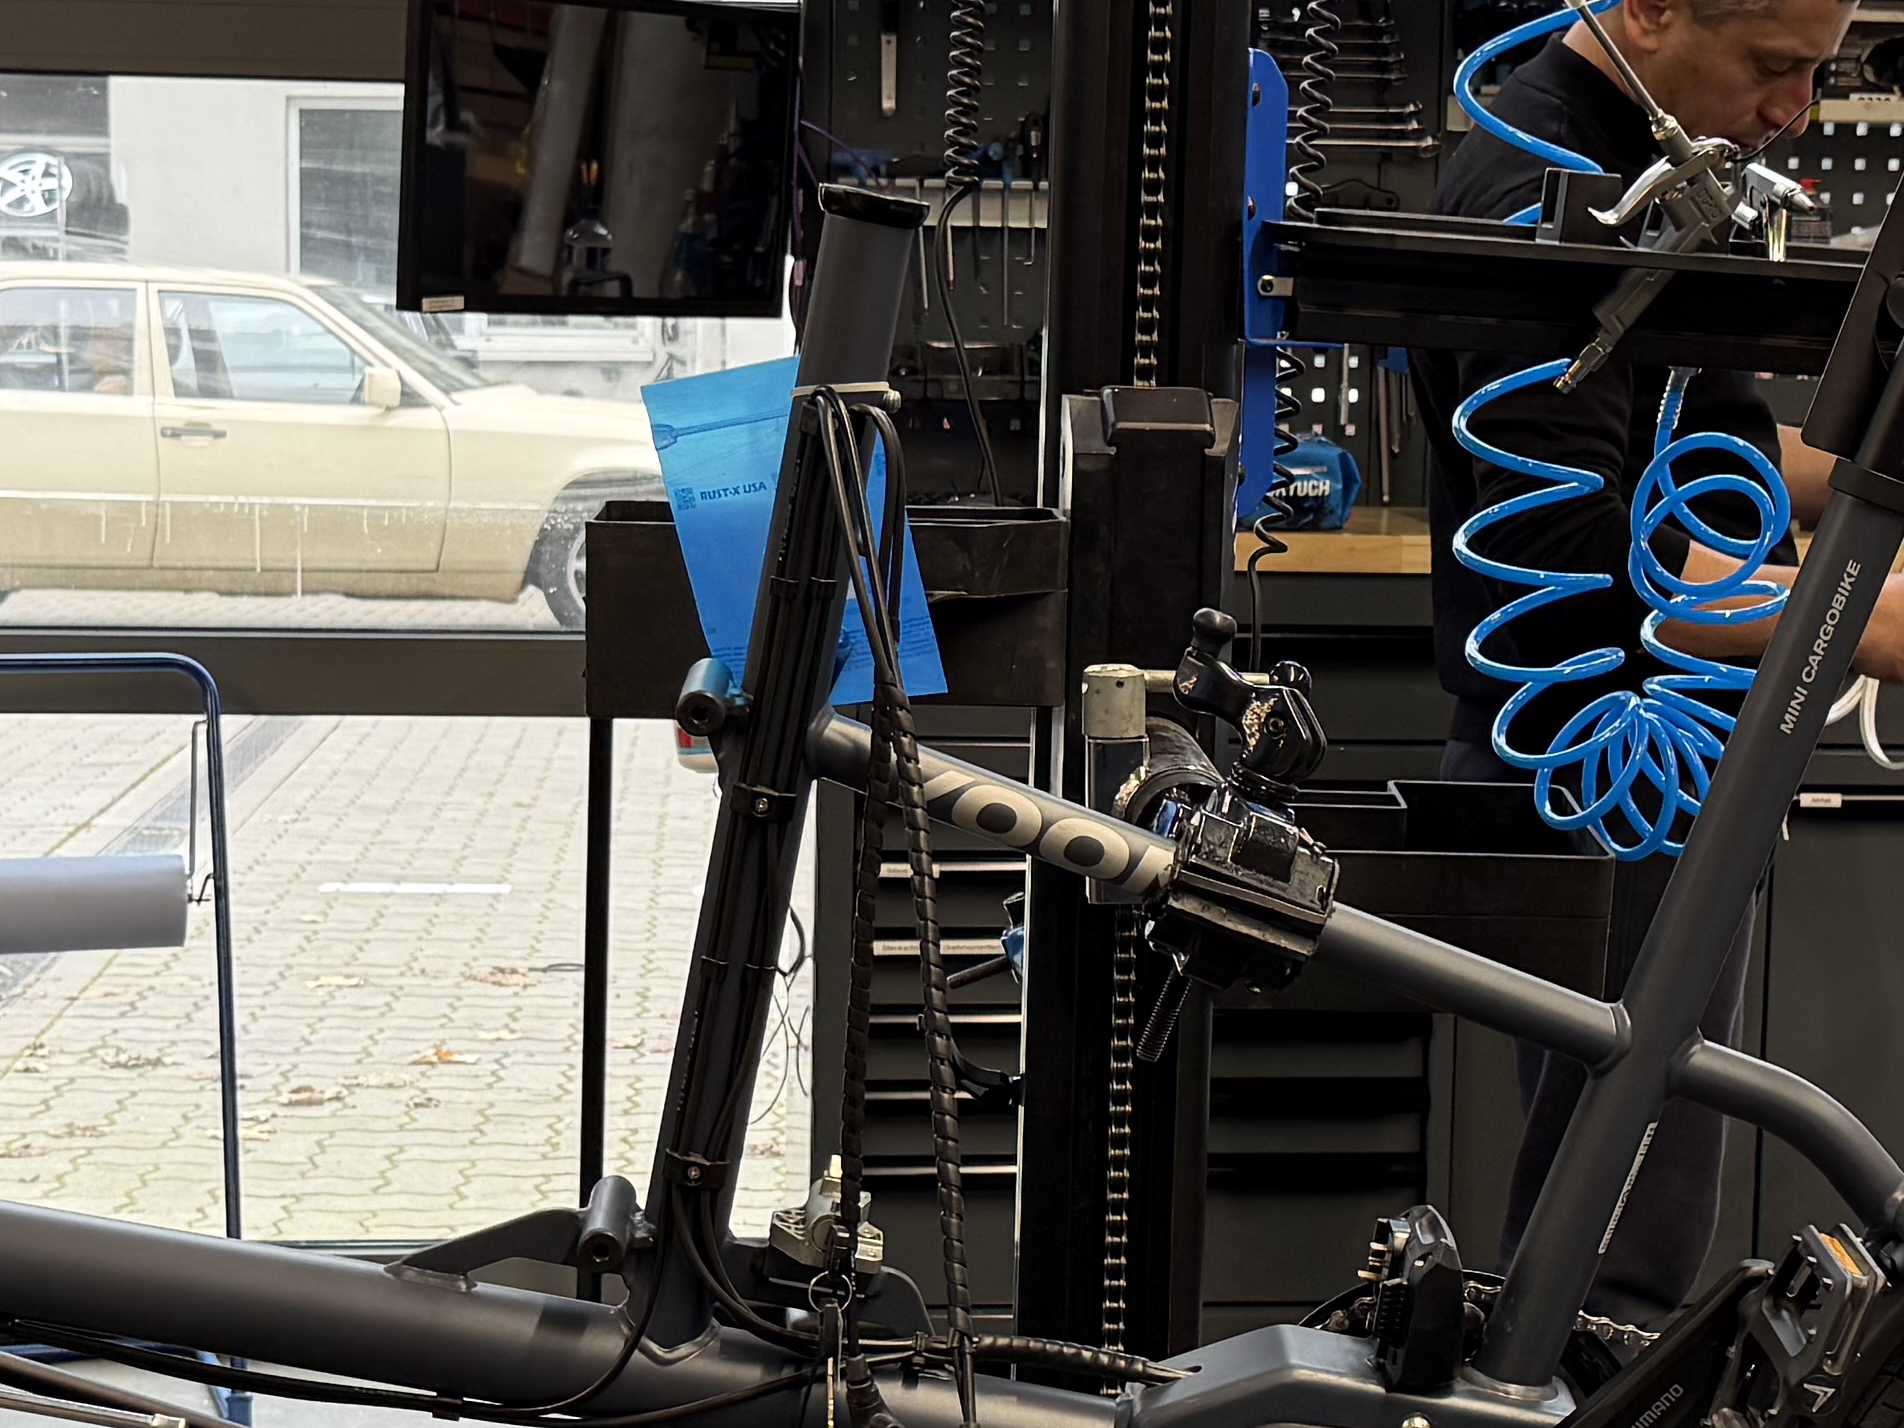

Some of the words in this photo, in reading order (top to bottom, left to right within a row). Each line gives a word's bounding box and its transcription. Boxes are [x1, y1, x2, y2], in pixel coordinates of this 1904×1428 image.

[742, 481, 767, 494] USA
[1779, 685, 1809, 735] MINI
[1801, 559, 1861, 684] CARGOBIKE
